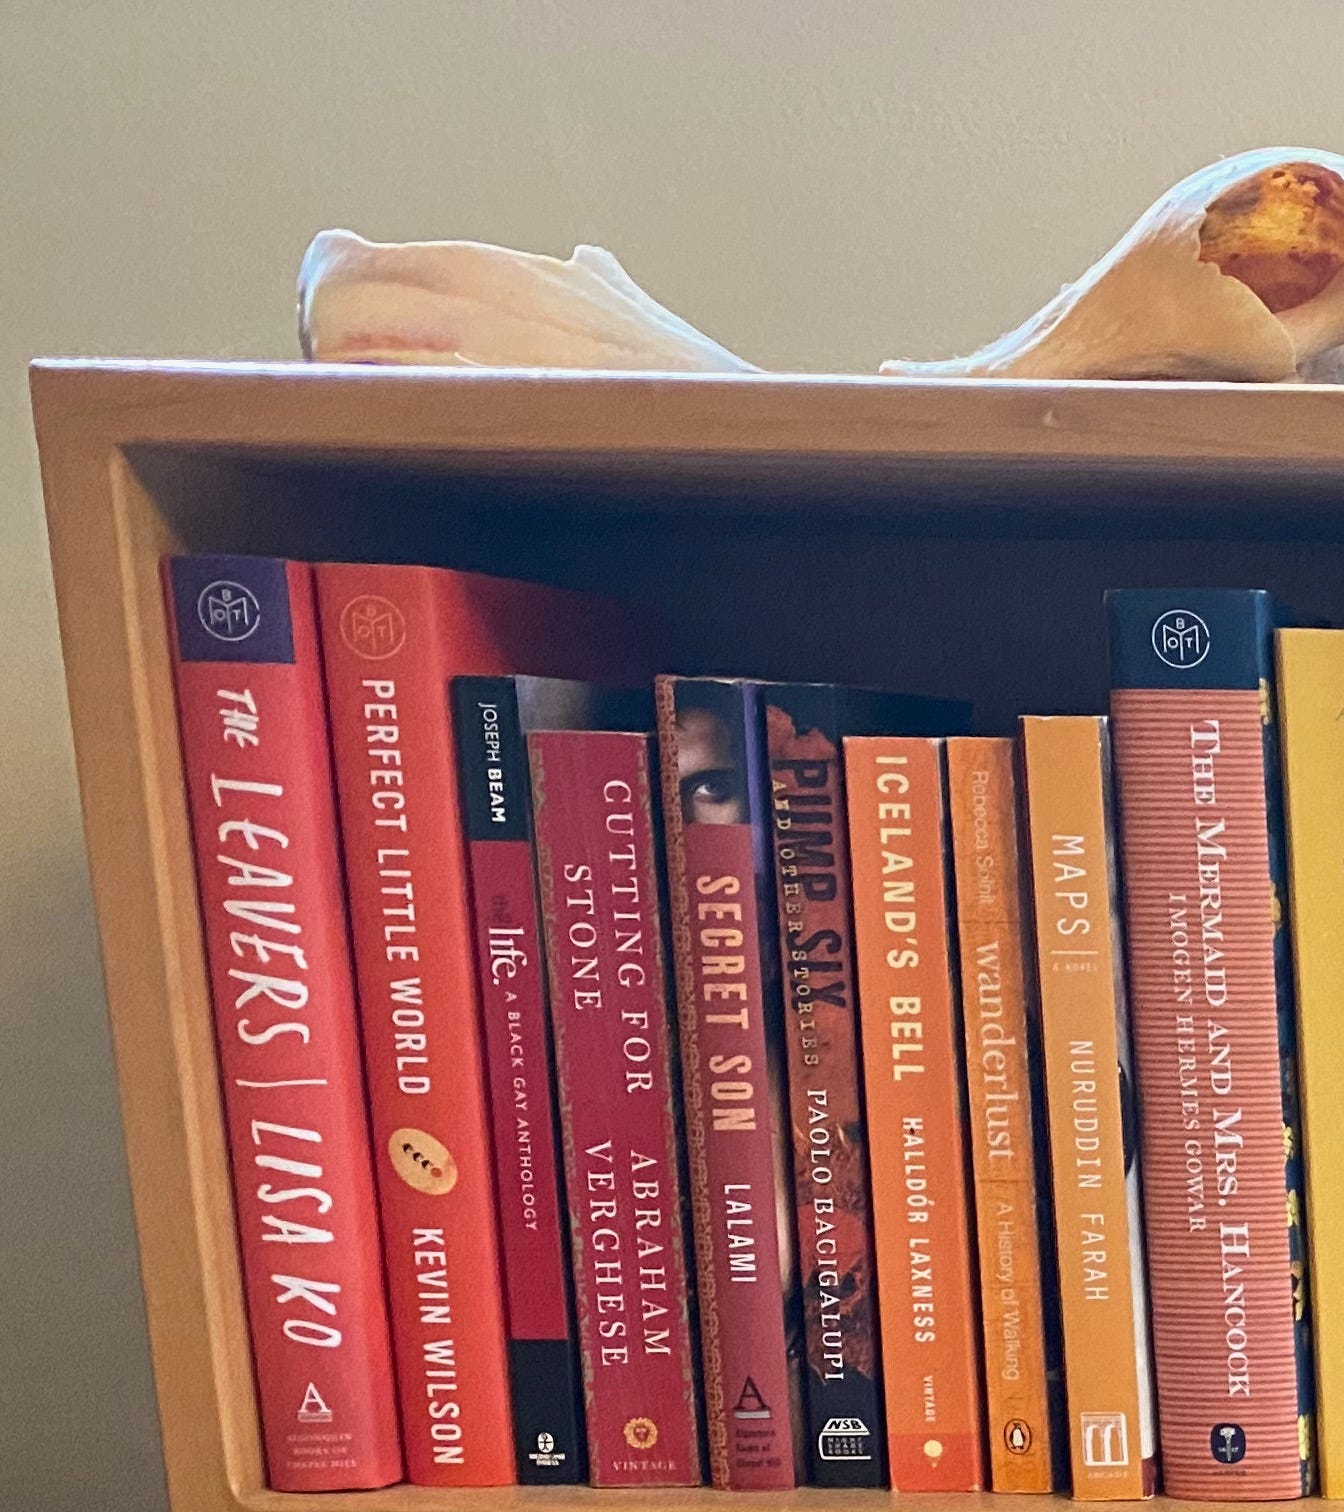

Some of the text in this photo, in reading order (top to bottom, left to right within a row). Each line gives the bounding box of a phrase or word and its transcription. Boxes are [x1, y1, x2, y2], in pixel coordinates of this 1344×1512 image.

[563, 863, 601, 1011] STONE
[602, 779, 653, 1093] CUTTING FOR
[1052, 834, 1090, 937] MAPS
[696, 874, 757, 1132] SECRET SON
[250, 1119, 334, 1245] LISA
[505, 992, 538, 1232] A BLACK GAY ANTHOLOGY
[1069, 1041, 1109, 1301] NURUDDIN FARAH
[270, 1273, 342, 1347] KO
[411, 1228, 464, 1465] KEVIN WILSON
[584, 1139, 629, 1367] VERGHESE
[630, 1150, 671, 1357] ABRAHAM
[996, 1203, 1021, 1381] A History of Walking
[923, 1375, 936, 1423] VINTAGE
